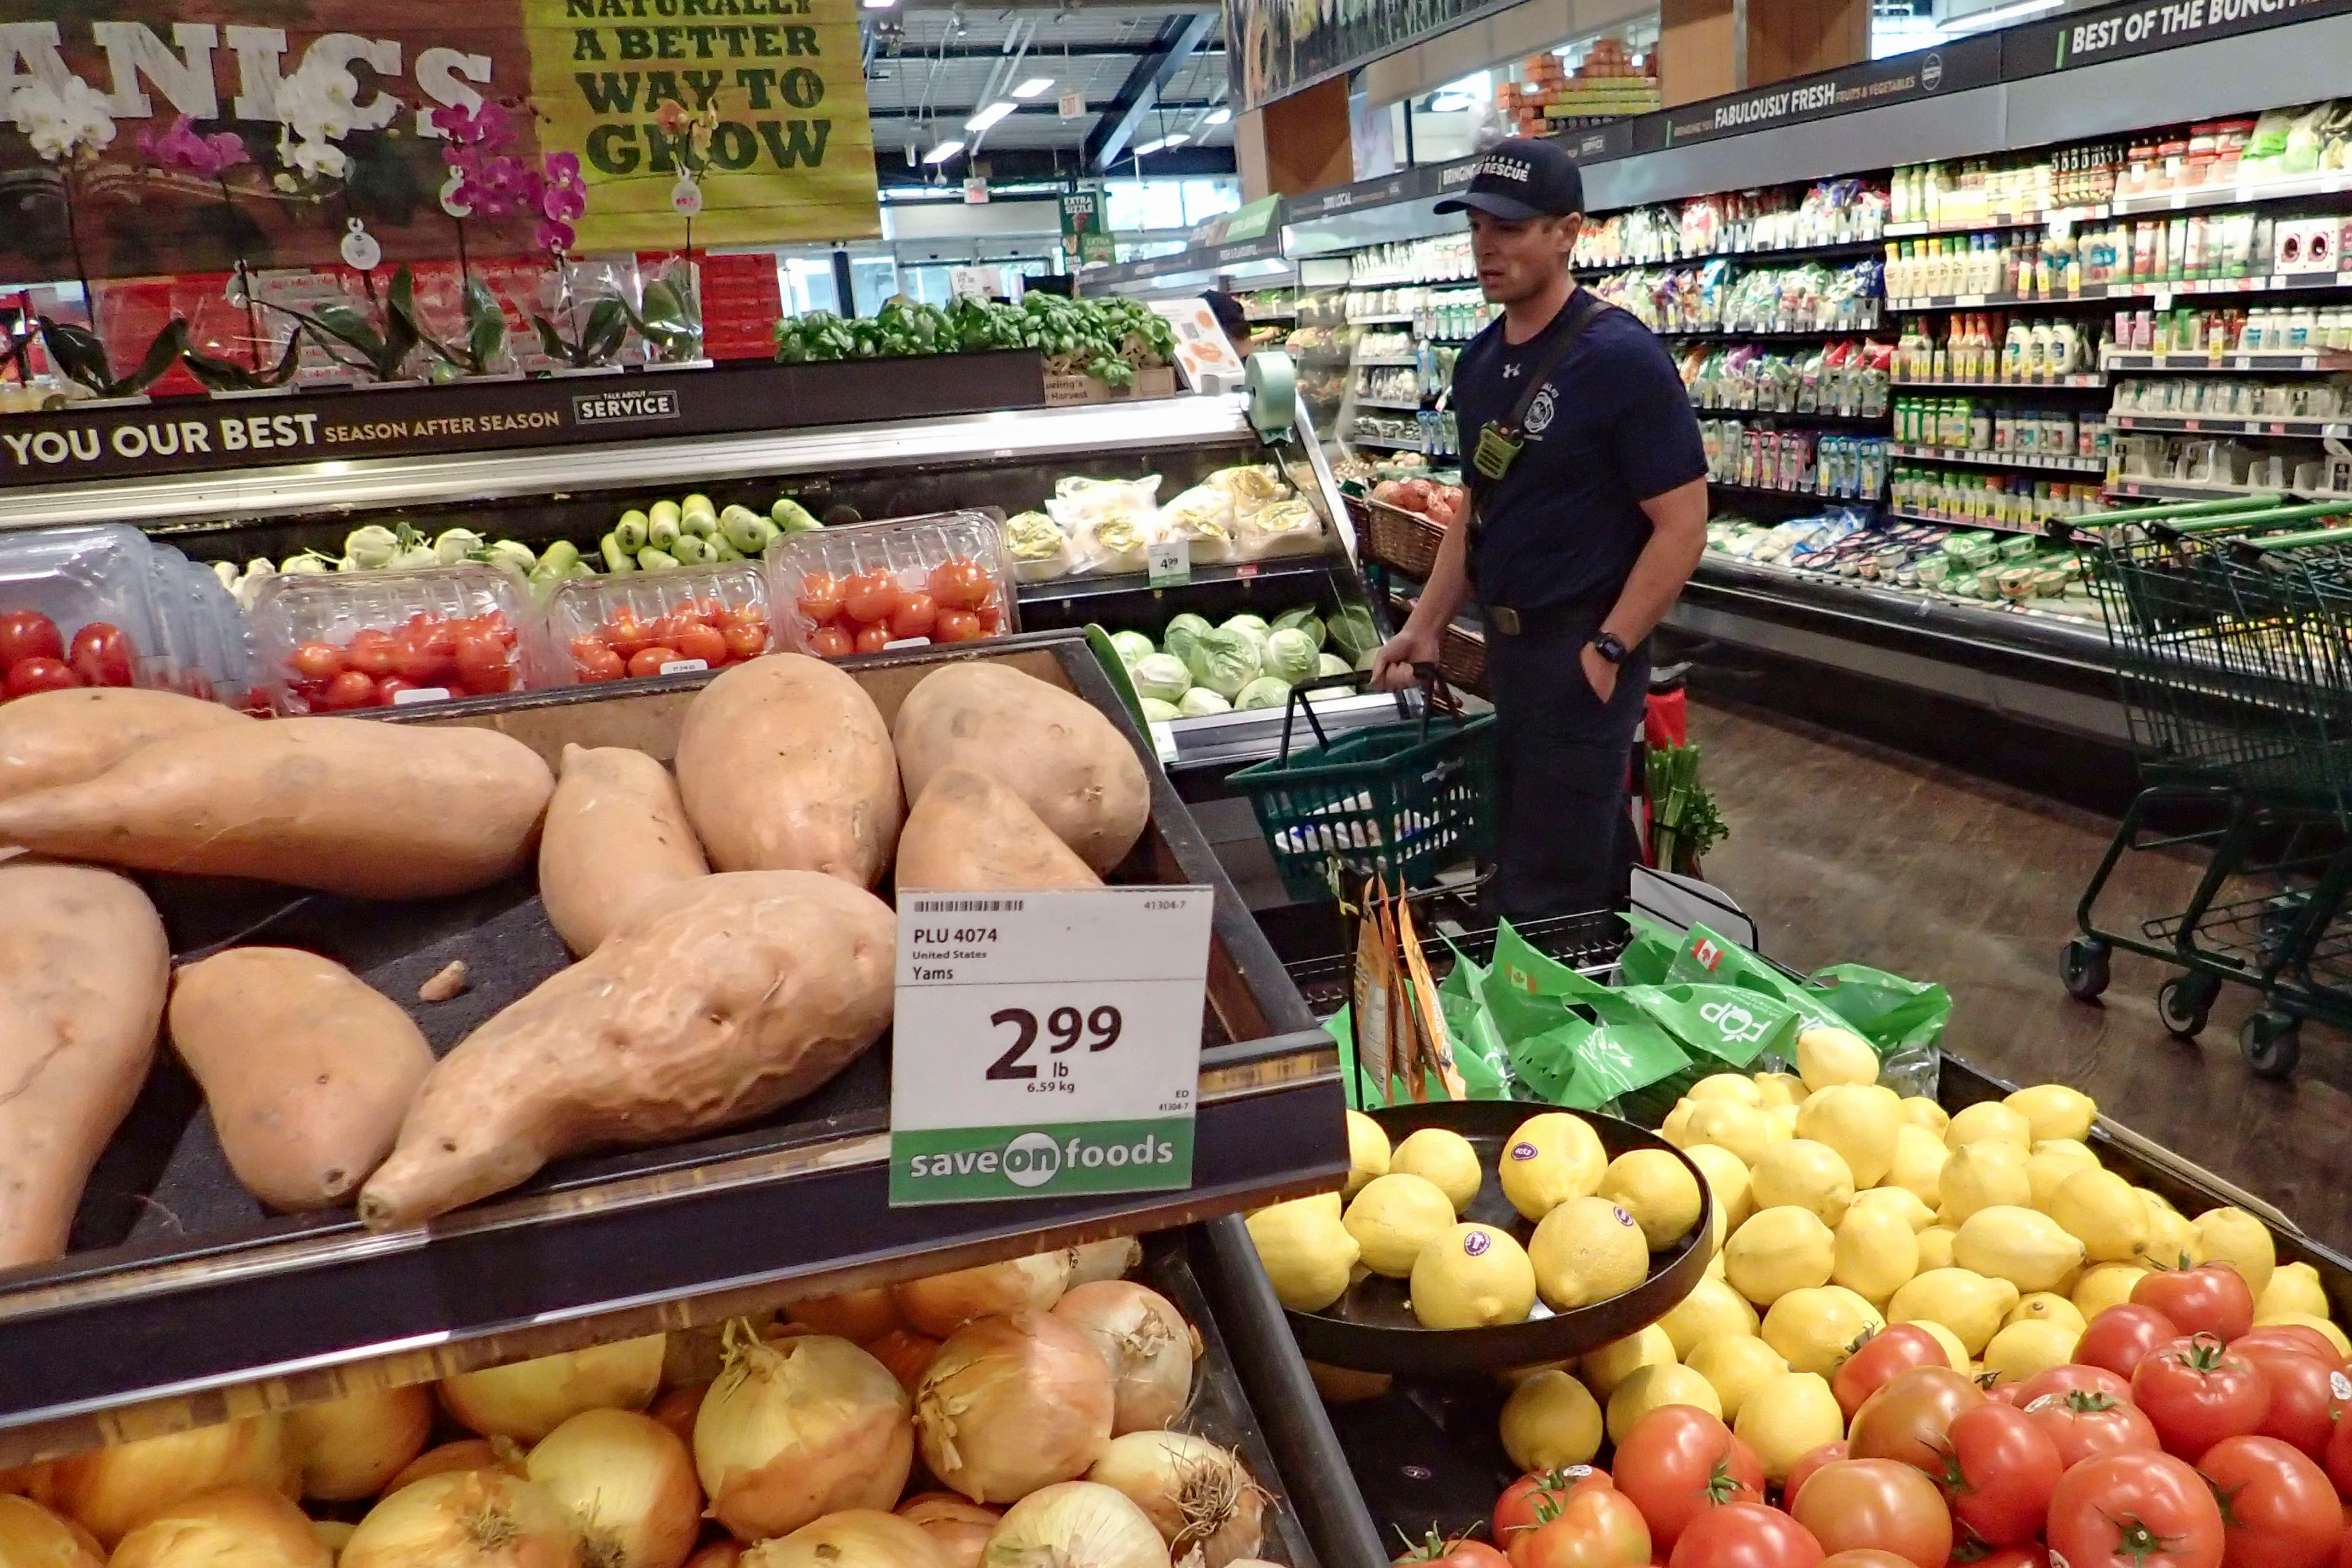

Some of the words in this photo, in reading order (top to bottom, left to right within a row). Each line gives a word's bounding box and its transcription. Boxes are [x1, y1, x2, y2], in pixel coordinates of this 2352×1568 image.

[2071, 18, 2122, 54] BEST
[2125, 8, 2157, 43] OF
[2161, 3, 2203, 36] THE
[573, 27, 607, 60] A
[615, 25, 821, 60] BETTER
[575, 69, 724, 114] WAY
[736, 67, 825, 109] TO
[1714, 92, 1790, 129] FABULOUSLY
[1791, 82, 1836, 113] FRESH
[586, 119, 832, 175] GROW
[1482, 162, 1528, 183] RESCUE
[1064, 196, 1092, 206] EXTRA
[604, 392, 621, 400] TALK
[621, 390, 647, 399] ABOUT
[1051, 390, 1089, 400] Harvest
[581, 397, 670, 418] SERVICE
[3, 428, 101, 465] YOU
[113, 420, 211, 458] OUR
[219, 414, 318, 451] BEST
[325, 422, 408, 443] SEASON
[413, 418, 476, 437] AFTER
[480, 411, 560, 431] SEASON
[1144, 900, 1186, 910] 41304-7
[914, 929, 949, 944] PLU
[953, 928, 998, 943] 4074
[913, 950, 950, 960] United
[953, 950, 987, 959] States
[913, 966, 953, 980] Yams
[1053, 1062, 1069, 1078] lb
[1027, 1082, 1056, 1093] 6.59
[1059, 1080, 1075, 1094] kg
[1176, 1090, 1189, 1098] ED
[910, 1149, 999, 1178] save
[1066, 1135, 1173, 1169] foods
